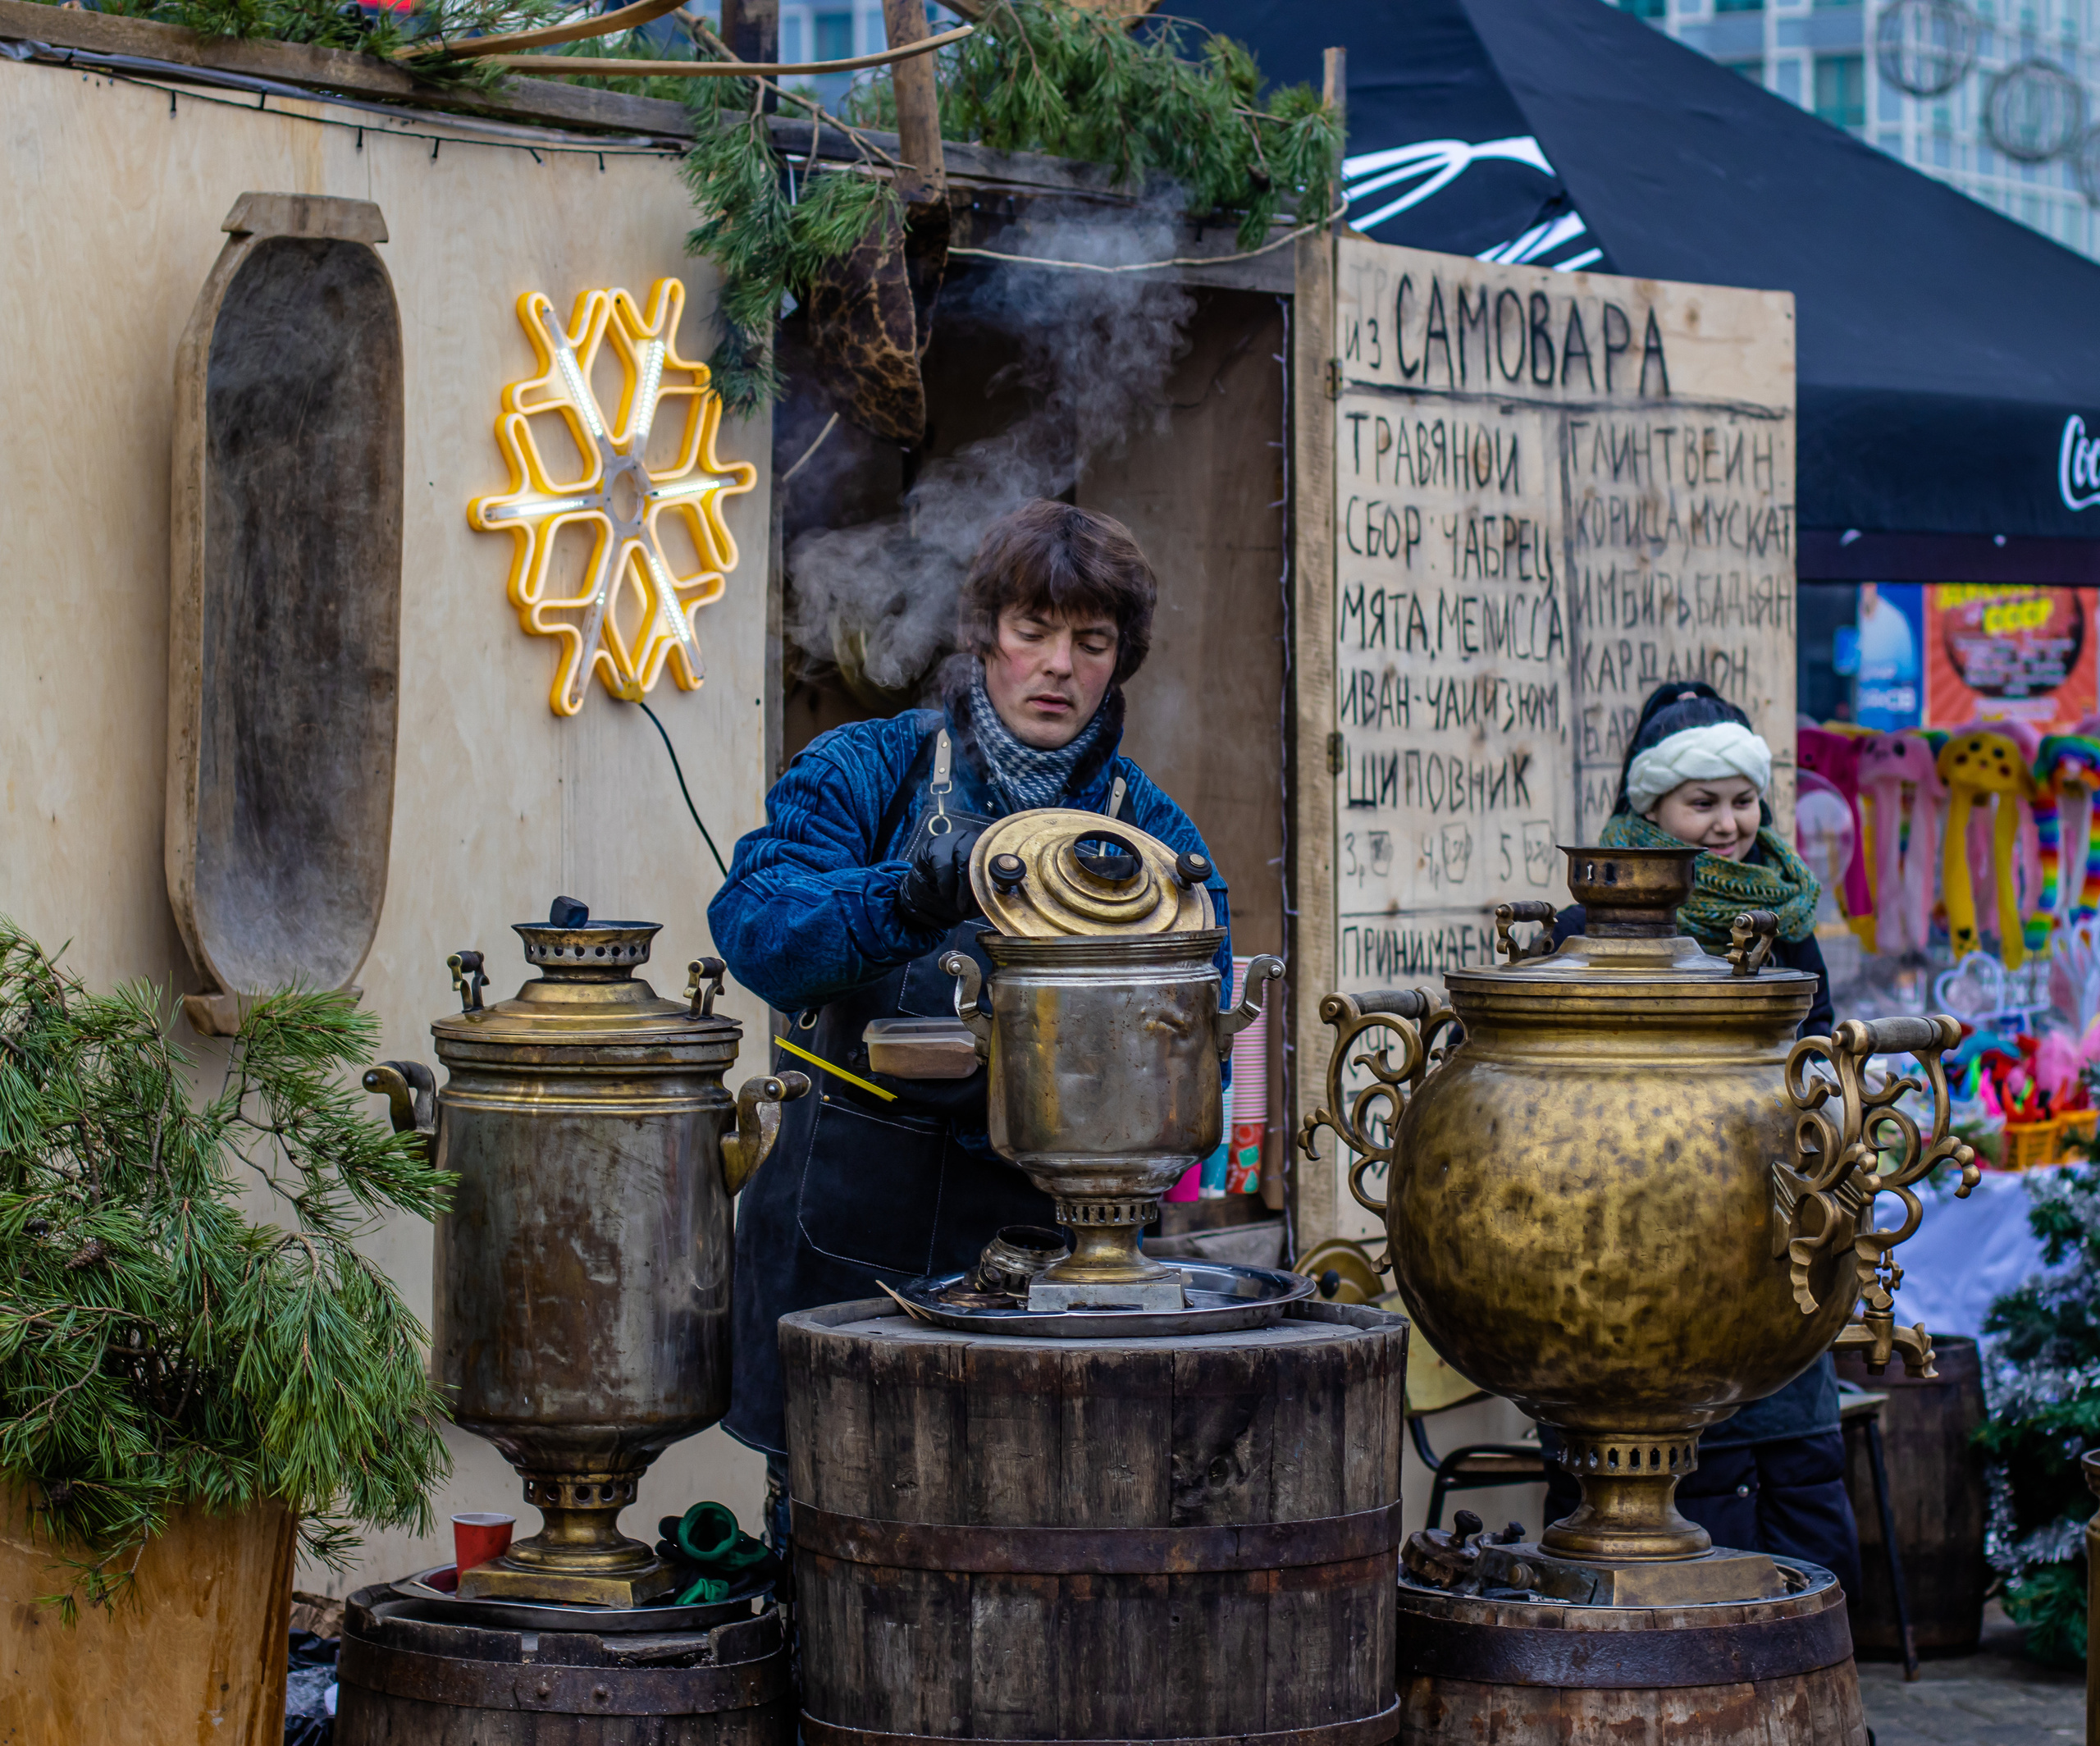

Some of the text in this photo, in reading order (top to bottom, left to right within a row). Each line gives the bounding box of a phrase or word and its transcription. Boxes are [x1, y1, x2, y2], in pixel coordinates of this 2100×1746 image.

[1396, 272, 1670, 396] САМОВАРА
[1346, 743, 1532, 814] ШИПОВНИК
[1343, 926, 1495, 983] ПРИНИМАЕМ
